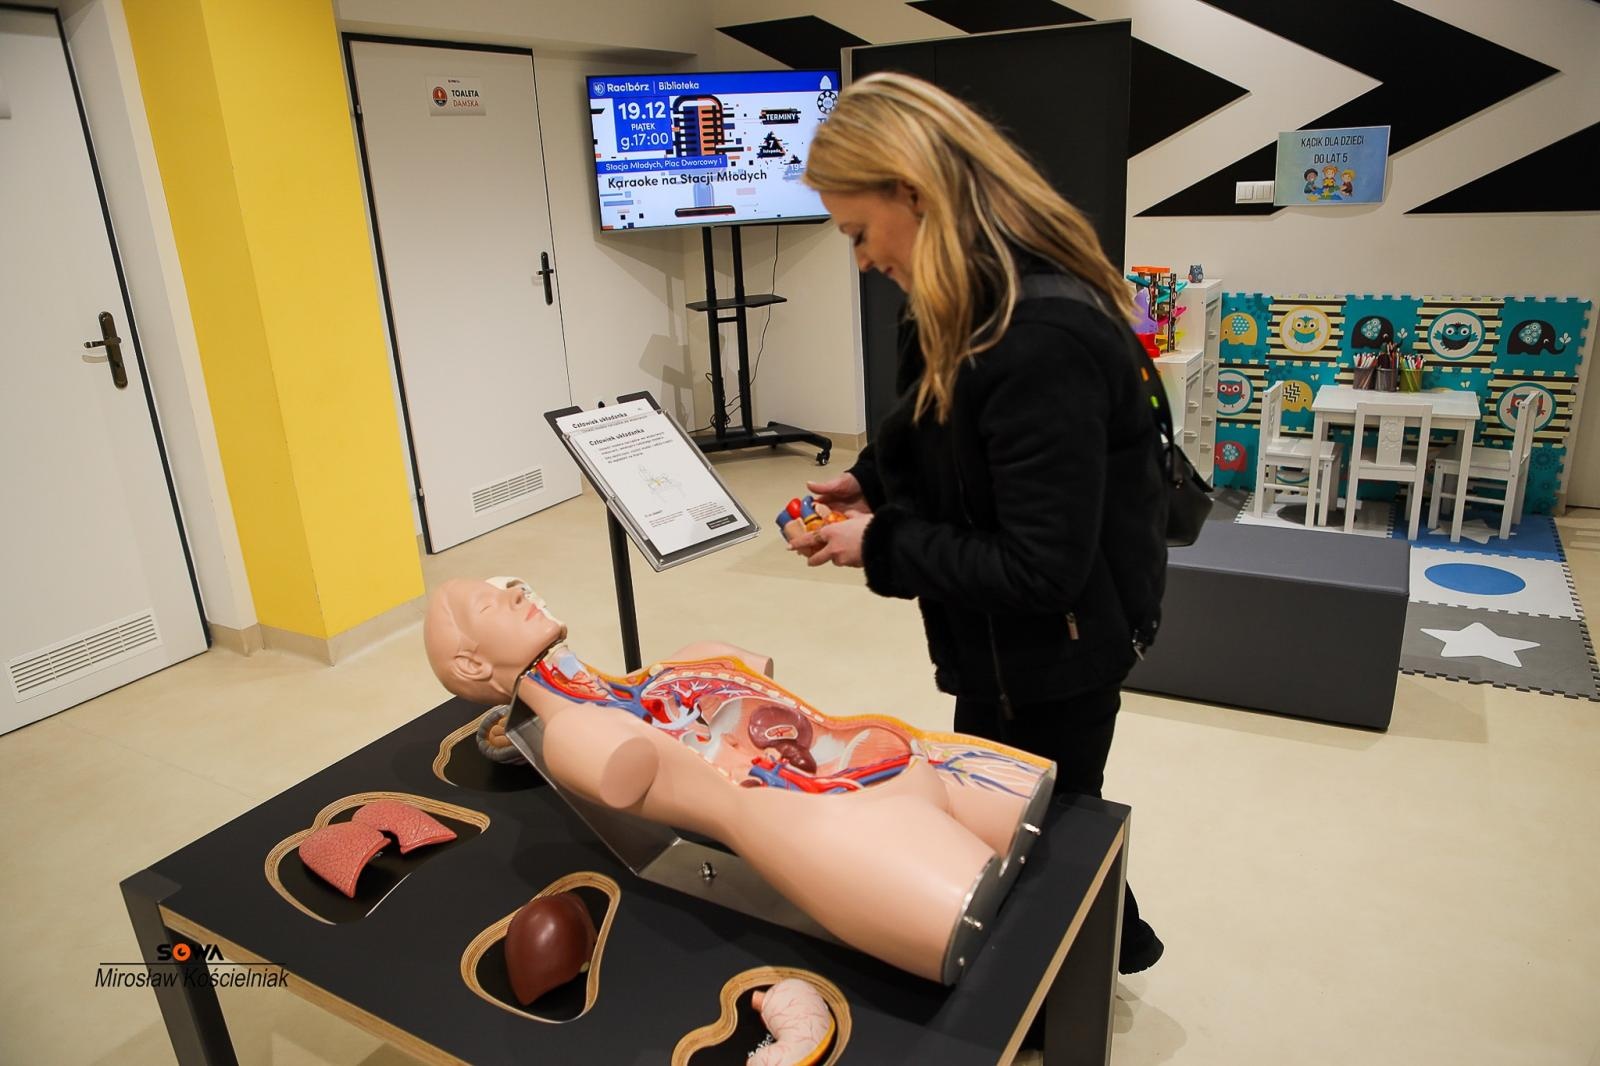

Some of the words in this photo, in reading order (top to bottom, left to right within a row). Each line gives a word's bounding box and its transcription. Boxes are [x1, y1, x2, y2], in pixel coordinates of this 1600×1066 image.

[607, 82, 650, 92] Racibórz
[658, 81, 700, 90] Biblioteka
[451, 90, 480, 98] TOALETA
[618, 102, 666, 120] 19.12
[766, 113, 796, 121] TERMINY
[631, 123, 656, 132] PIĄTEK
[620, 132, 669, 150] g.17:00
[1301, 136, 1322, 148] KĄCIK
[1324, 136, 1339, 146] DLA
[1340, 135, 1364, 146] DZIECI
[606, 162, 628, 171] Stacja
[630, 160, 662, 170] Młodych,
[681, 158, 717, 168] Dworcowy
[1314, 154, 1324, 164] DO
[1326, 153, 1341, 163] LAT
[1342, 152, 1348, 162] 5
[608, 177, 658, 188] Karaoke
[662, 177, 677, 186] na
[680, 172, 714, 185] Stacji
[717, 169, 768, 183] Młodych
[572, 418, 599, 428] Człowiek
[599, 412, 628, 423] układanka
[588, 436, 616, 446] Człowiek
[616, 428, 646, 439] układanka
